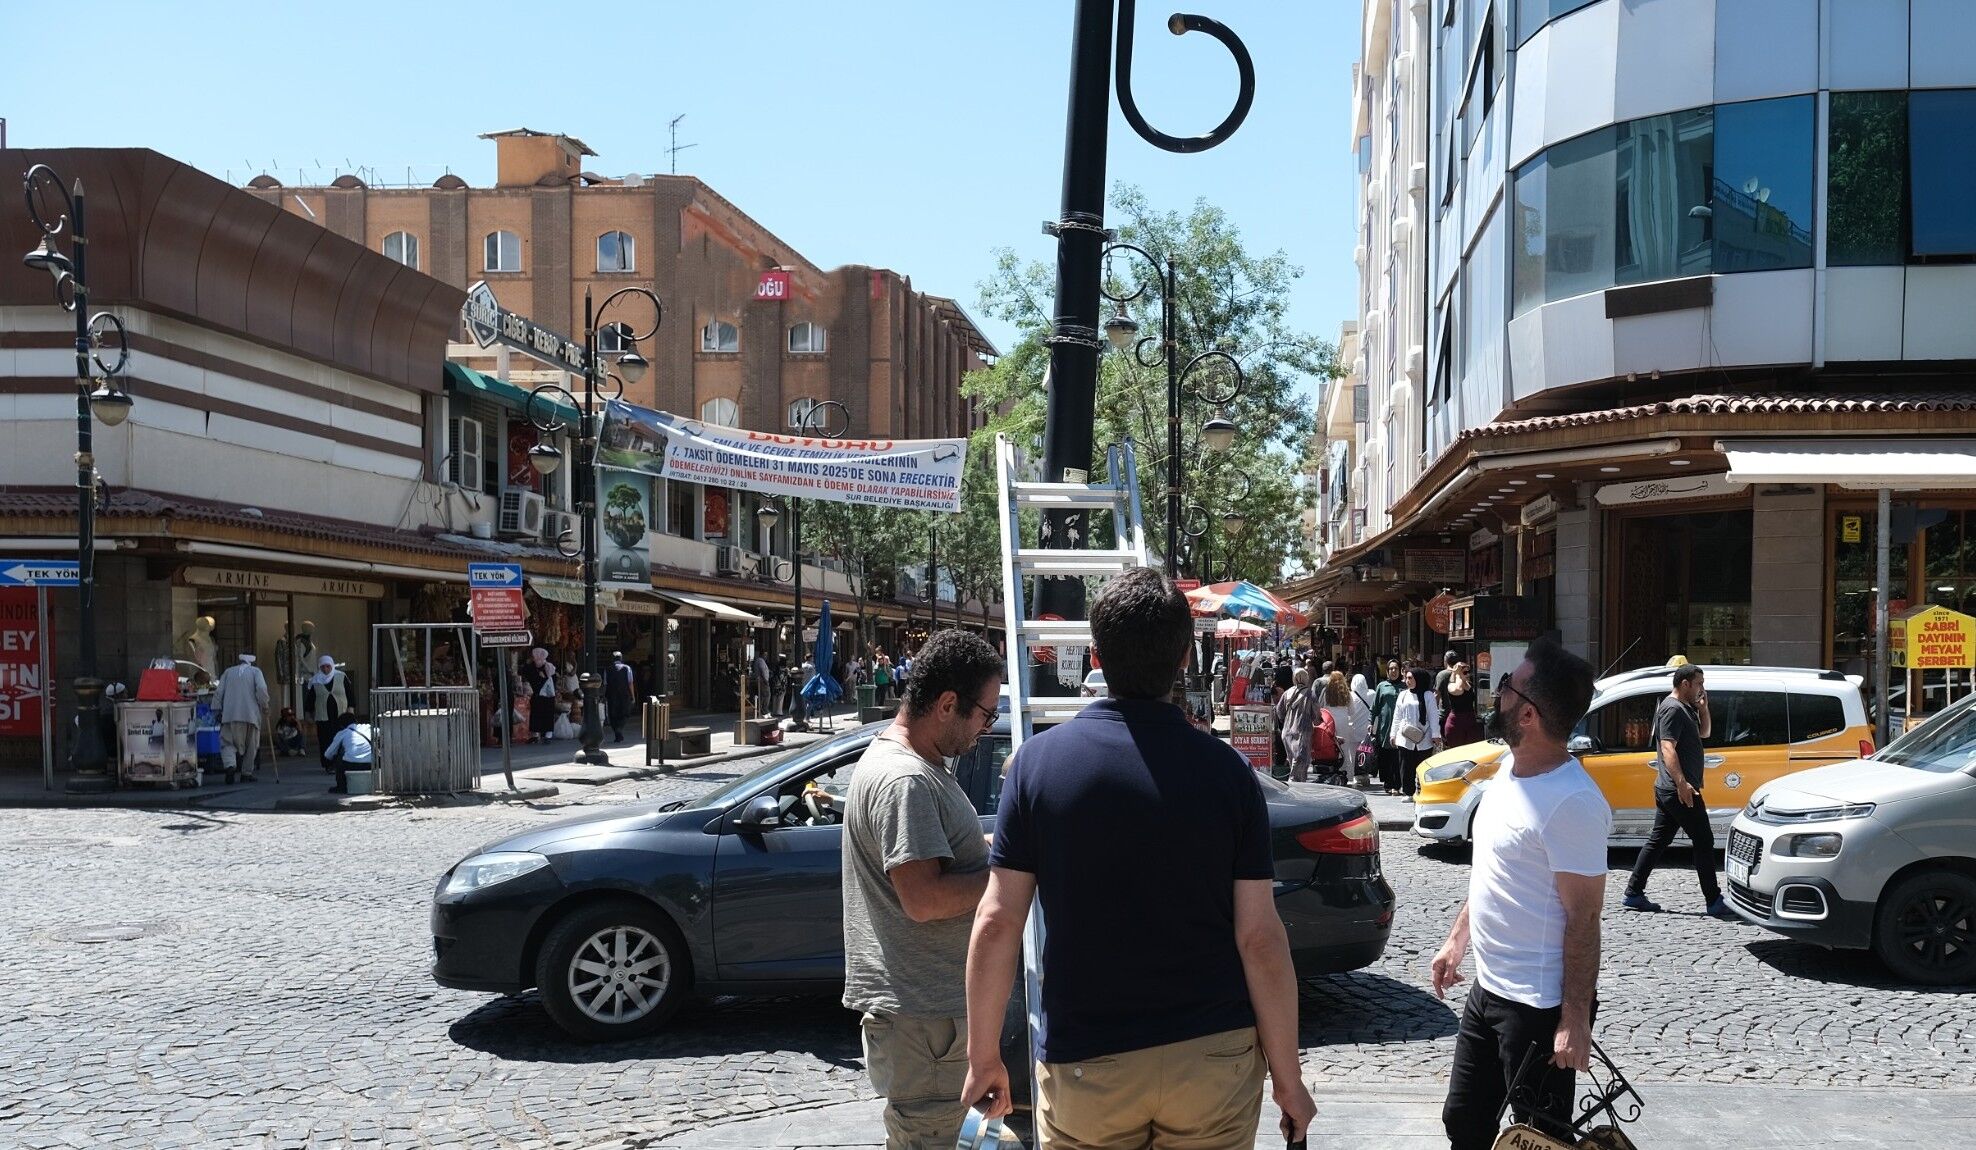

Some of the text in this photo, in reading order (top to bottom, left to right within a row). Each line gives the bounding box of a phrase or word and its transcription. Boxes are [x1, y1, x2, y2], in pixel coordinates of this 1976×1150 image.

[747, 444, 761, 453] VE
[684, 447, 713, 461] TAKSİT
[772, 460, 784, 472] 31
[822, 464, 865, 480] 2025'DE
[868, 470, 896, 483] SONA
[900, 472, 959, 488] ERECEKTİR.
[759, 471, 814, 488] SAYFAMIZDAN
[816, 479, 822, 488] E
[857, 483, 889, 495] OLARAK
[845, 493, 954, 509] SUR BELEDİYE BAŞKANLIĞI
[27, 569, 79, 578] TEK YÖN
[215, 572, 270, 587] ARMİNE
[474, 572, 505, 580] TEK YÖN
[321, 580, 365, 595] ARMİNE
[1924, 620, 1959, 632] SABRİ
[0, 630, 36, 651] EY
[1917, 633, 1966, 643] DAYININ
[1921, 645, 1962, 655] MEYAN
[1917, 654, 1966, 667] ŞERBETİ
[1510, 1133, 1551, 1150] Asi
